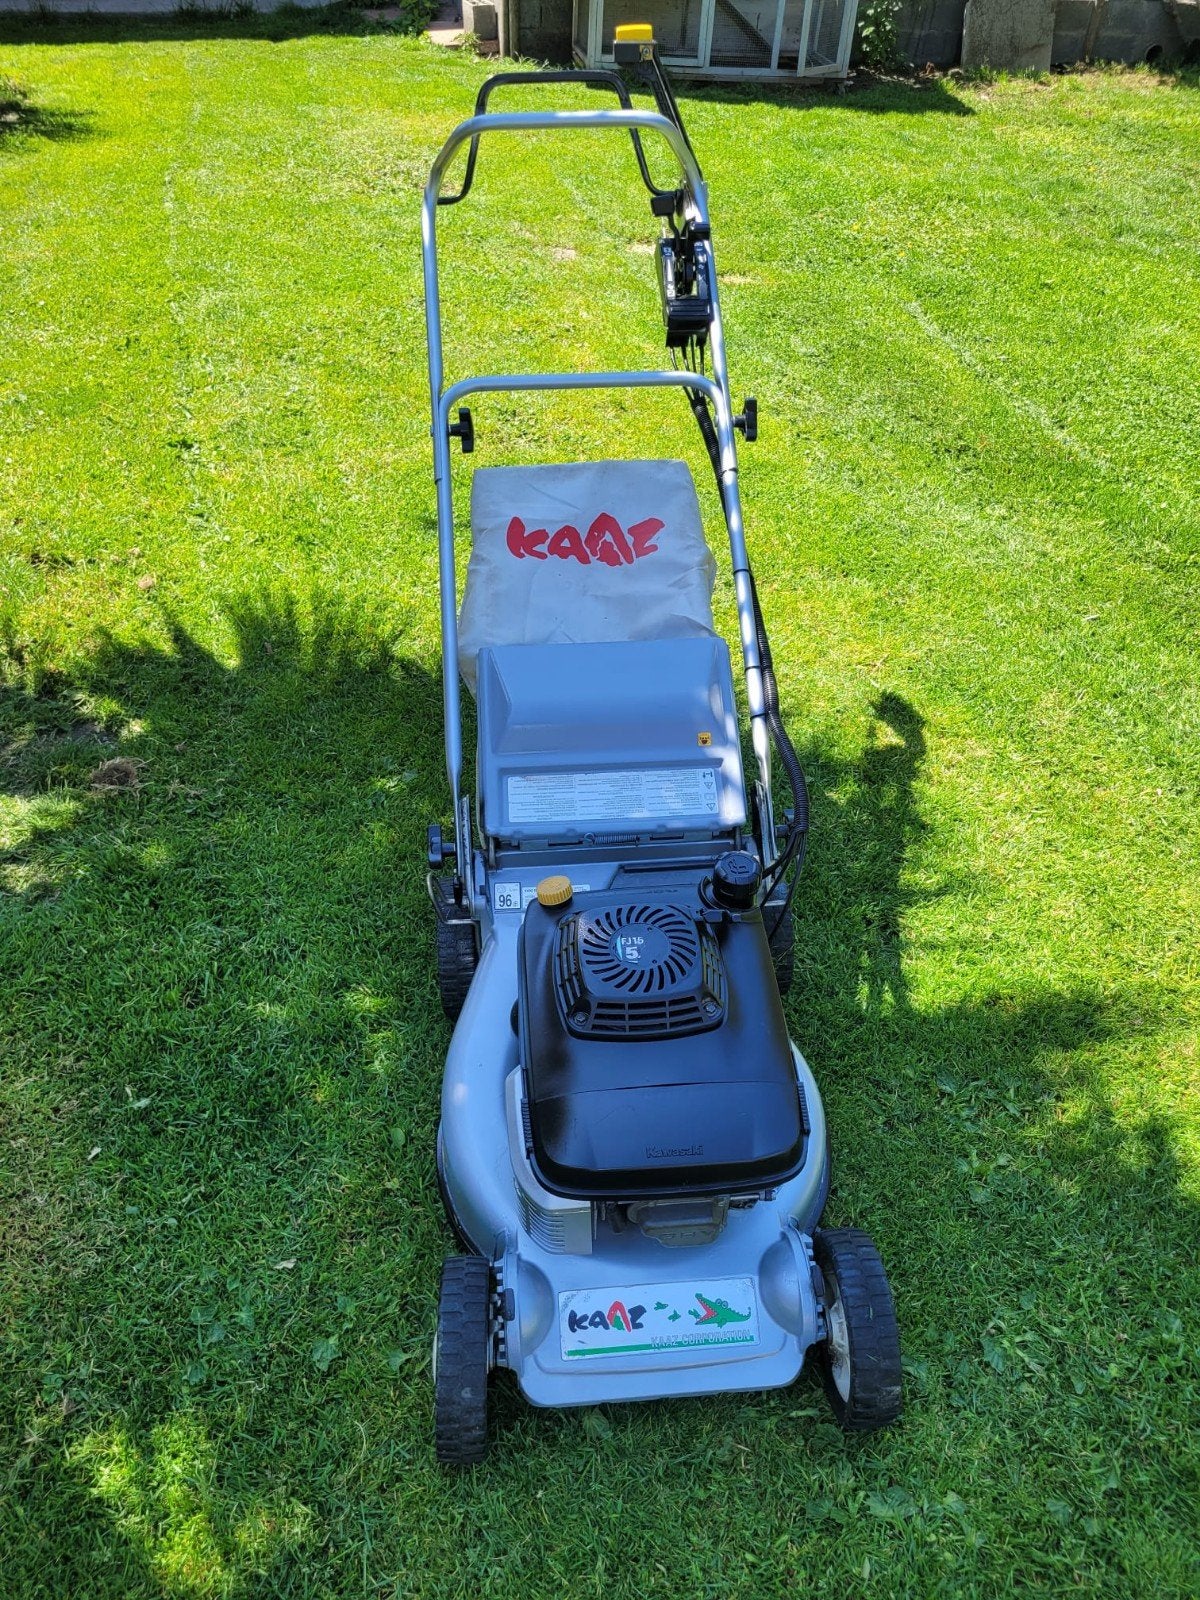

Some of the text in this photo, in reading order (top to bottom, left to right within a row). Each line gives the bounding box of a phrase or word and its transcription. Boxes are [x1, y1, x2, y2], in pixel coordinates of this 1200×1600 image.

[498, 894, 512, 907] 96
[645, 1145, 704, 1158] Kawasaki
[568, 1300, 647, 1333] KAAZ
[651, 1329, 750, 1349] KAAZ CORPORATION
